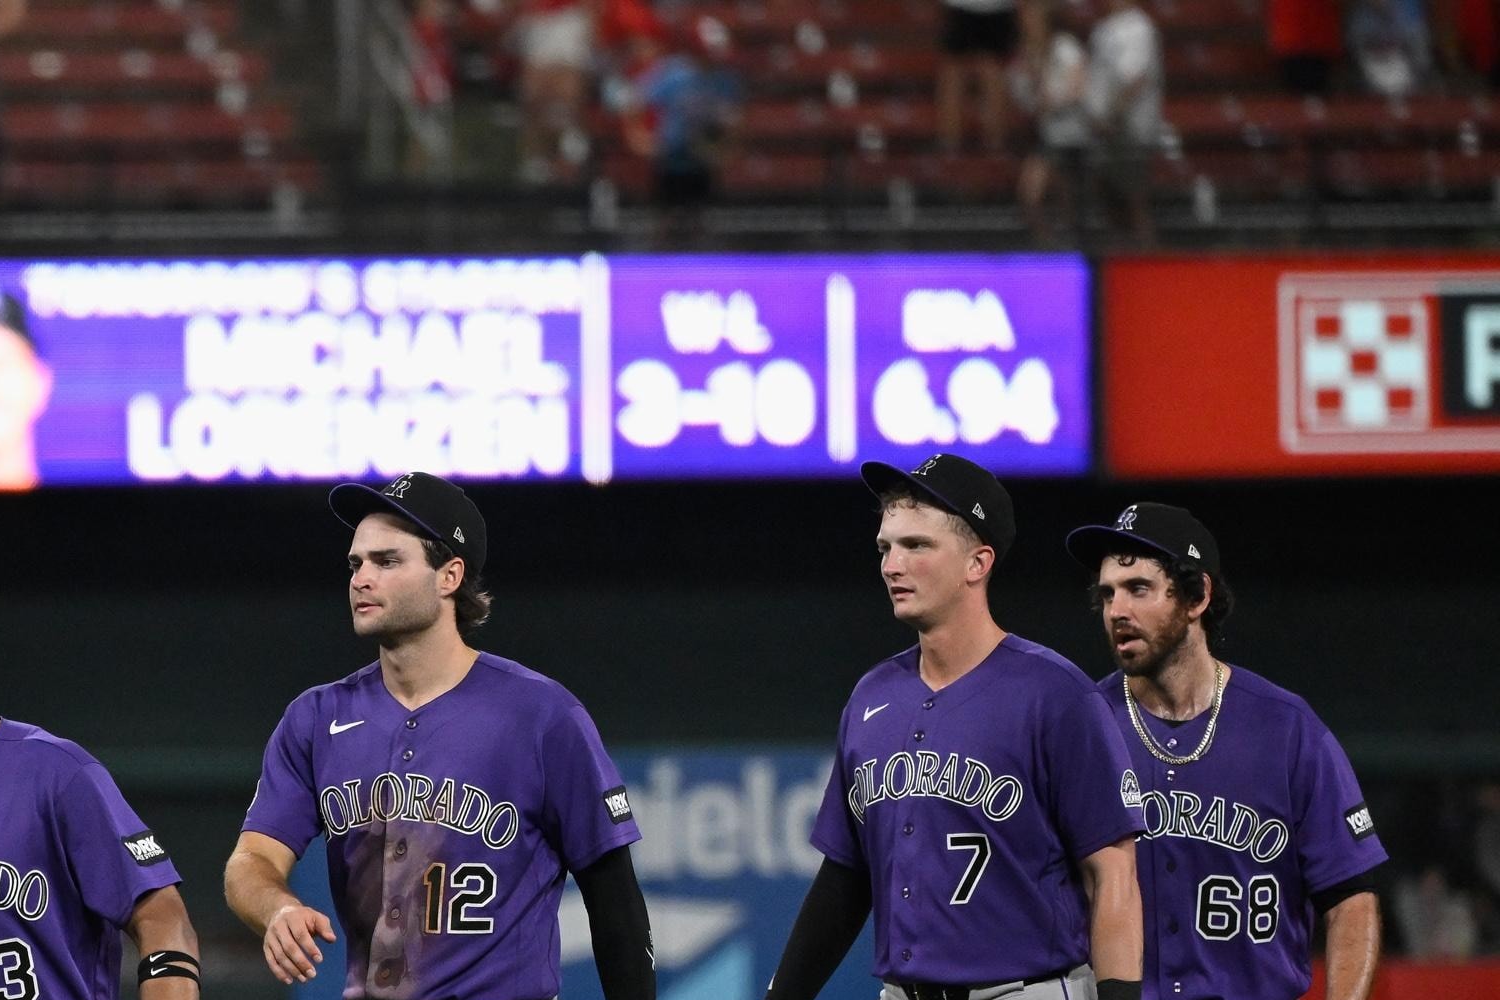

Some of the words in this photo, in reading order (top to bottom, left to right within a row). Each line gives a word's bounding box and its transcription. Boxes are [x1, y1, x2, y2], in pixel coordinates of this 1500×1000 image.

[184, 312, 569, 394] MICHAEL
[127, 393, 570, 479] LORENZEN
[319, 772, 520, 850] OLORADO
[423, 862, 498, 935] 12
[946, 832, 991, 905] 7
[1195, 874, 1280, 944] 68
